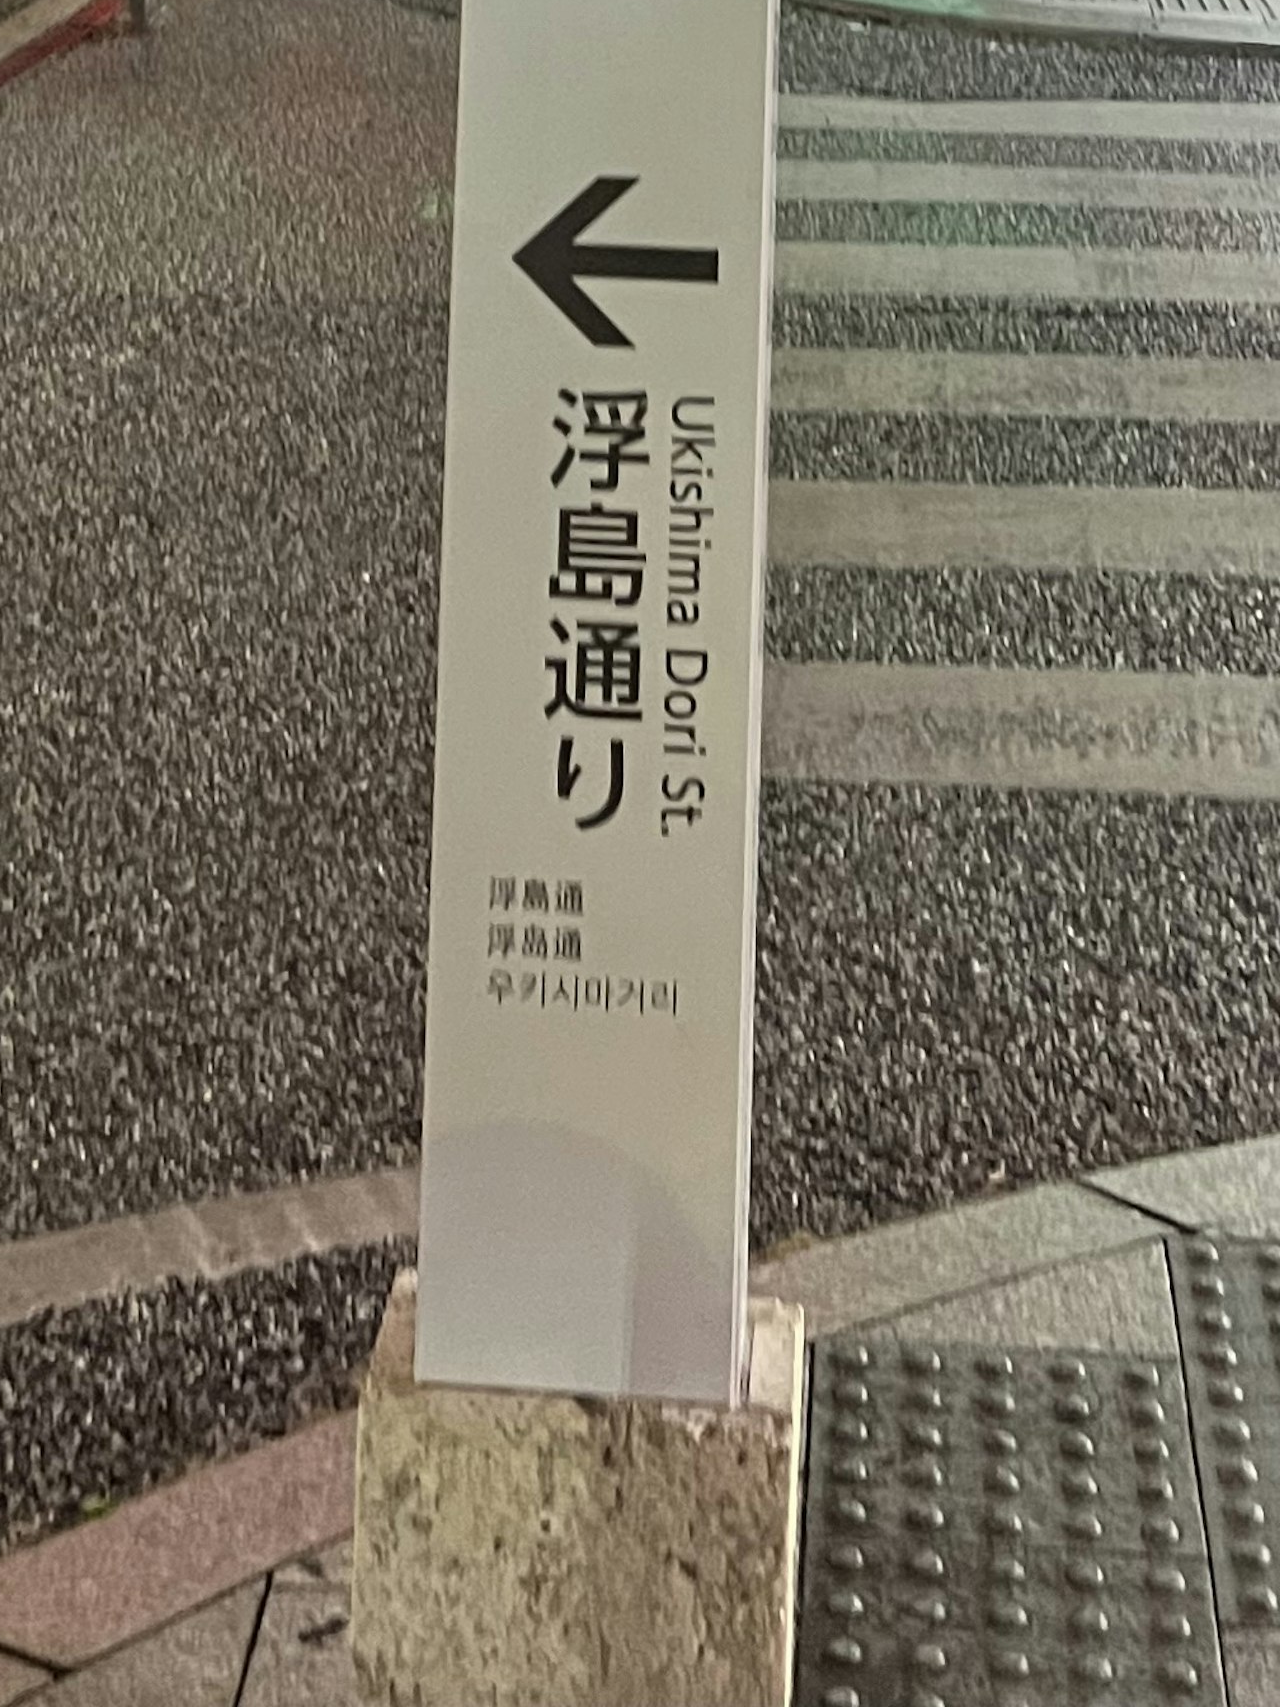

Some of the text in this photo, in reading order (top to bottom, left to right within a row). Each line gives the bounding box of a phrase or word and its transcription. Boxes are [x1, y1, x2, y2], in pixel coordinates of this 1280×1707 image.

[543, 387, 651, 832] 浮島通り
[661, 396, 716, 838] Ukishima Dori St.
